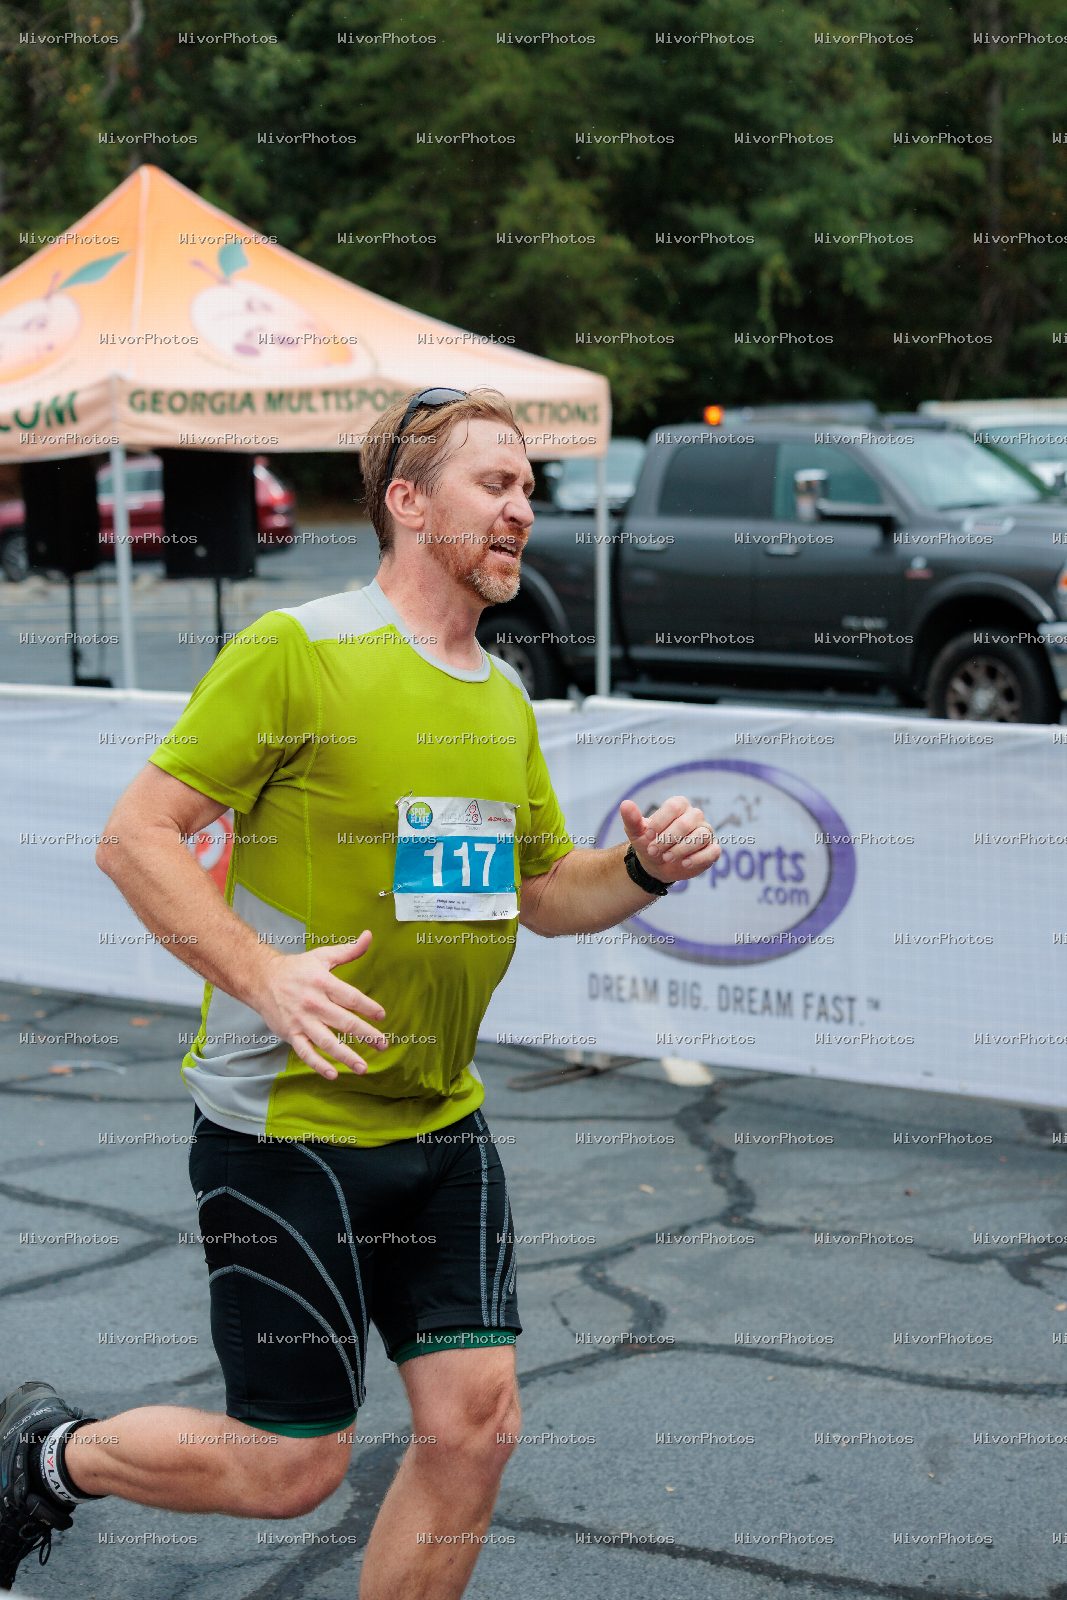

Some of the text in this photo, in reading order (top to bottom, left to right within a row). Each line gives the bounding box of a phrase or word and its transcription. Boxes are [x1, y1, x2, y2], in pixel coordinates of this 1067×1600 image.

[128, 389, 255, 415] GEORGIA
[423, 841, 497, 887] 117
[708, 845, 806, 888] ports
[759, 885, 810, 907] .com
[588, 971, 659, 1005] DREAM
[667, 979, 709, 1011] BIG.
[717, 982, 794, 1019] DREAM
